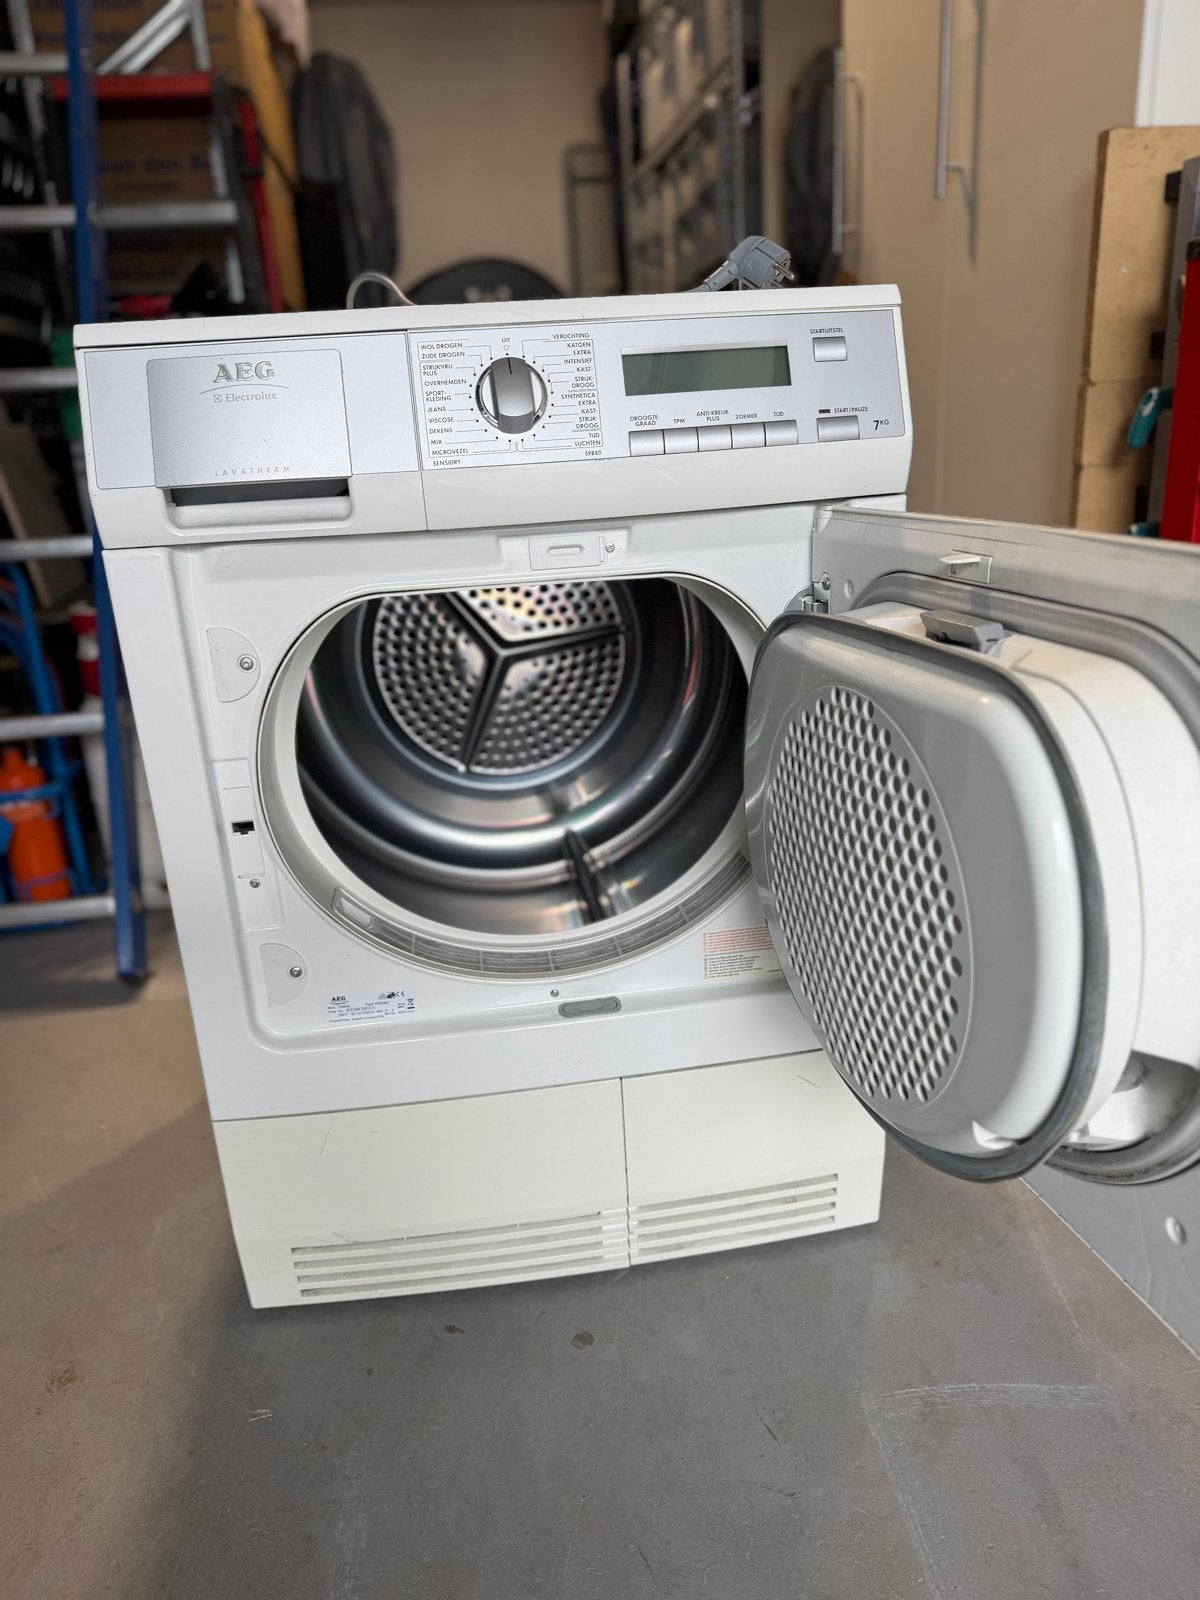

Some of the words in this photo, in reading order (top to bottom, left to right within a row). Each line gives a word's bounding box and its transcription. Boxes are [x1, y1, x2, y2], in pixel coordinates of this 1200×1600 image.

[552, 332, 589, 340] VERLICHTING
[213, 361, 275, 383] AEG
[225, 392, 277, 403] Electrolux
[215, 466, 291, 477] LAVATHERM
